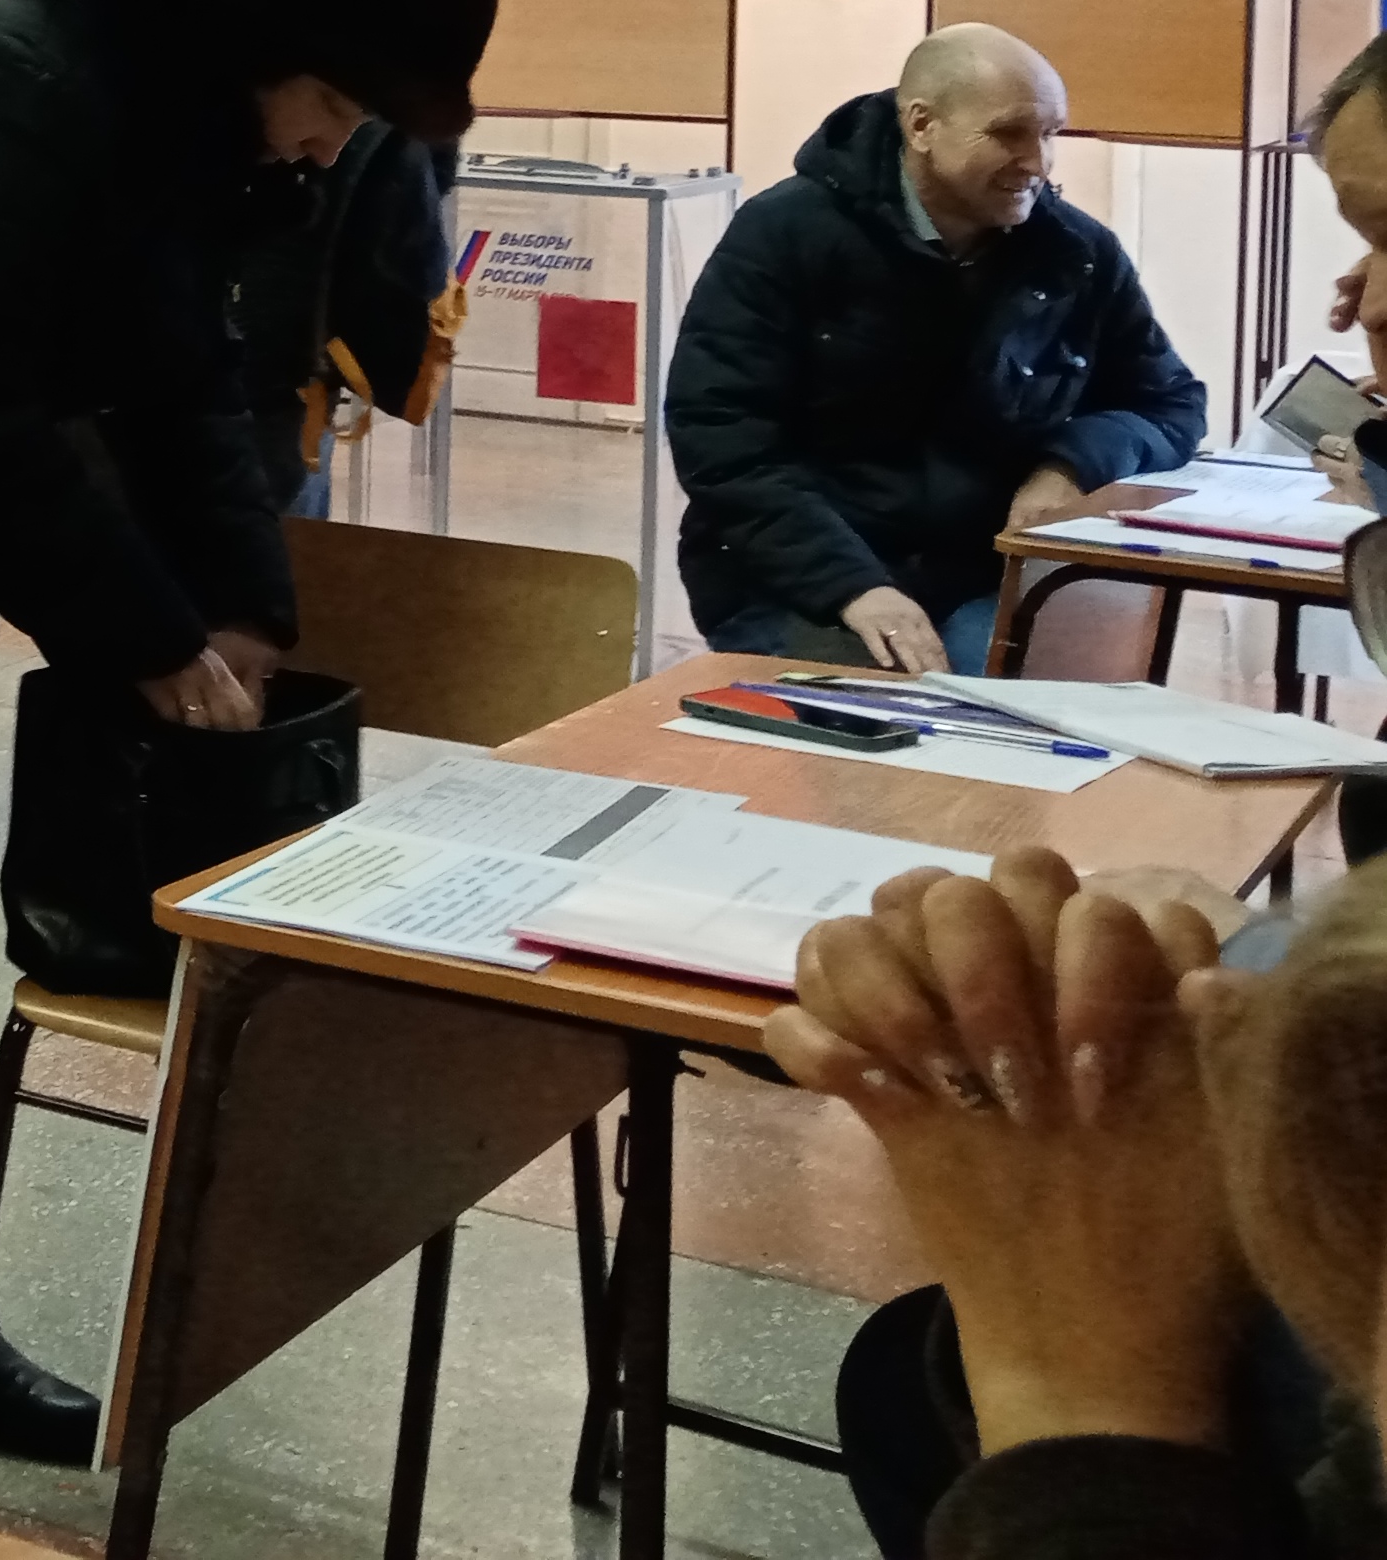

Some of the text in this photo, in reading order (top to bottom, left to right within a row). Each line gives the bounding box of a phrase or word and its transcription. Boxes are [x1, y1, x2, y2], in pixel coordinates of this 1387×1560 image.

[498, 232, 572, 250] ВЫБОРЫ
[489, 251, 594, 272] ПРЕЗИДЕНТА
[481, 269, 548, 285] РОССИИ
